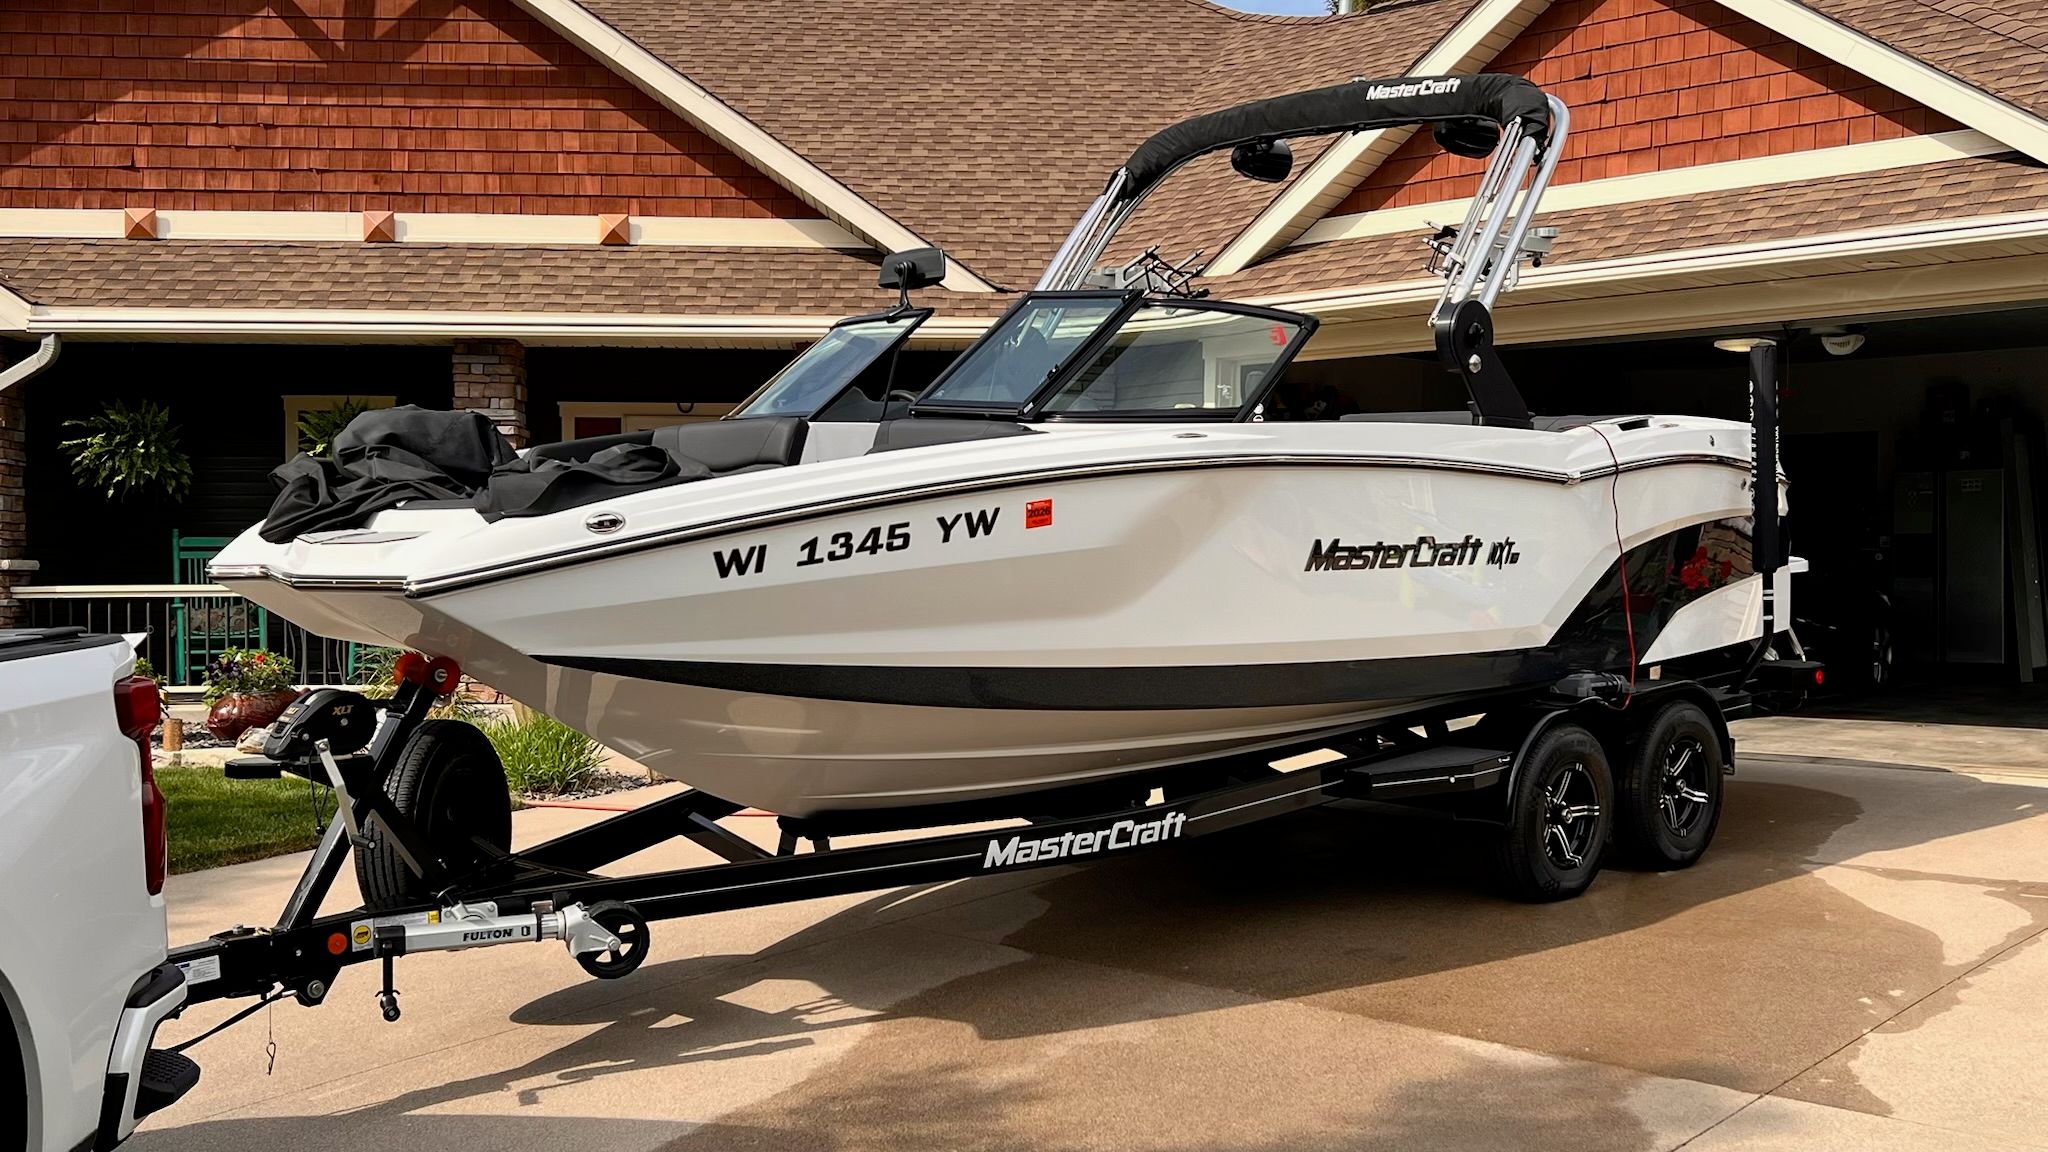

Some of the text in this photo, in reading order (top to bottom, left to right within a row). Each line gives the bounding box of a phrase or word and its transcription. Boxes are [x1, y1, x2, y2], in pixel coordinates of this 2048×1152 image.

[1366, 77, 1461, 101] MasterCraft
[713, 507, 1001, 579] WI 1345 YW
[1304, 535, 1483, 572] MasterCraft
[332, 704, 354, 716] XLT
[983, 811, 1187, 869] MasterCraft
[463, 927, 514, 942] FULTON
